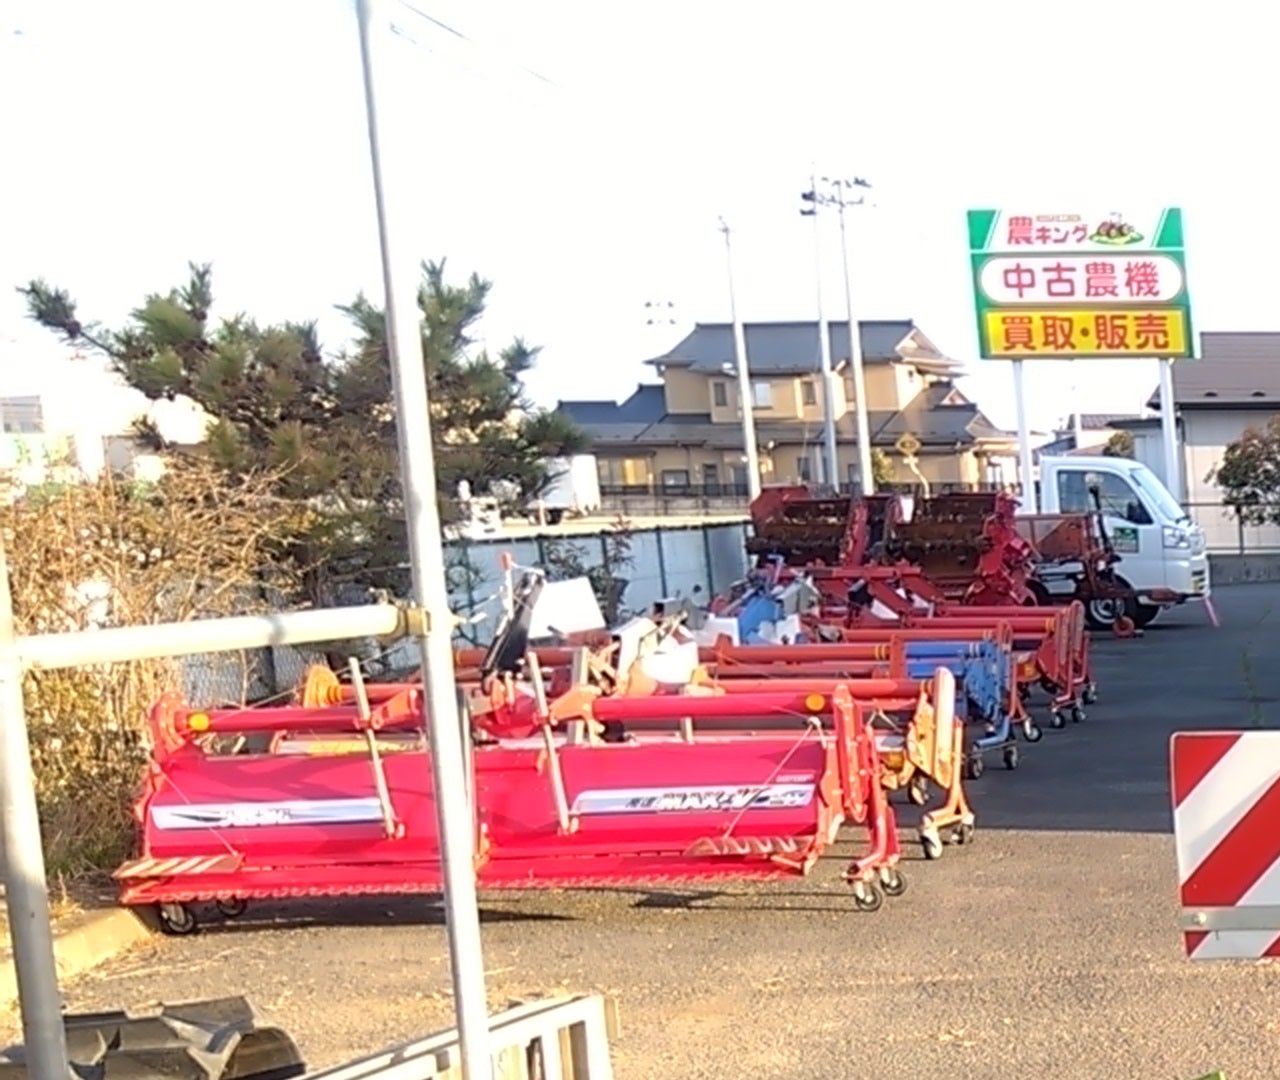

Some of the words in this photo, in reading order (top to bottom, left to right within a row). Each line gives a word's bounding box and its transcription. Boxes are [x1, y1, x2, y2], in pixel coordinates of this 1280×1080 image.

[1007, 215, 1088, 245] 農キング
[1003, 261, 1160, 298] 中古農機
[1001, 313, 1170, 351] 買取・販売
